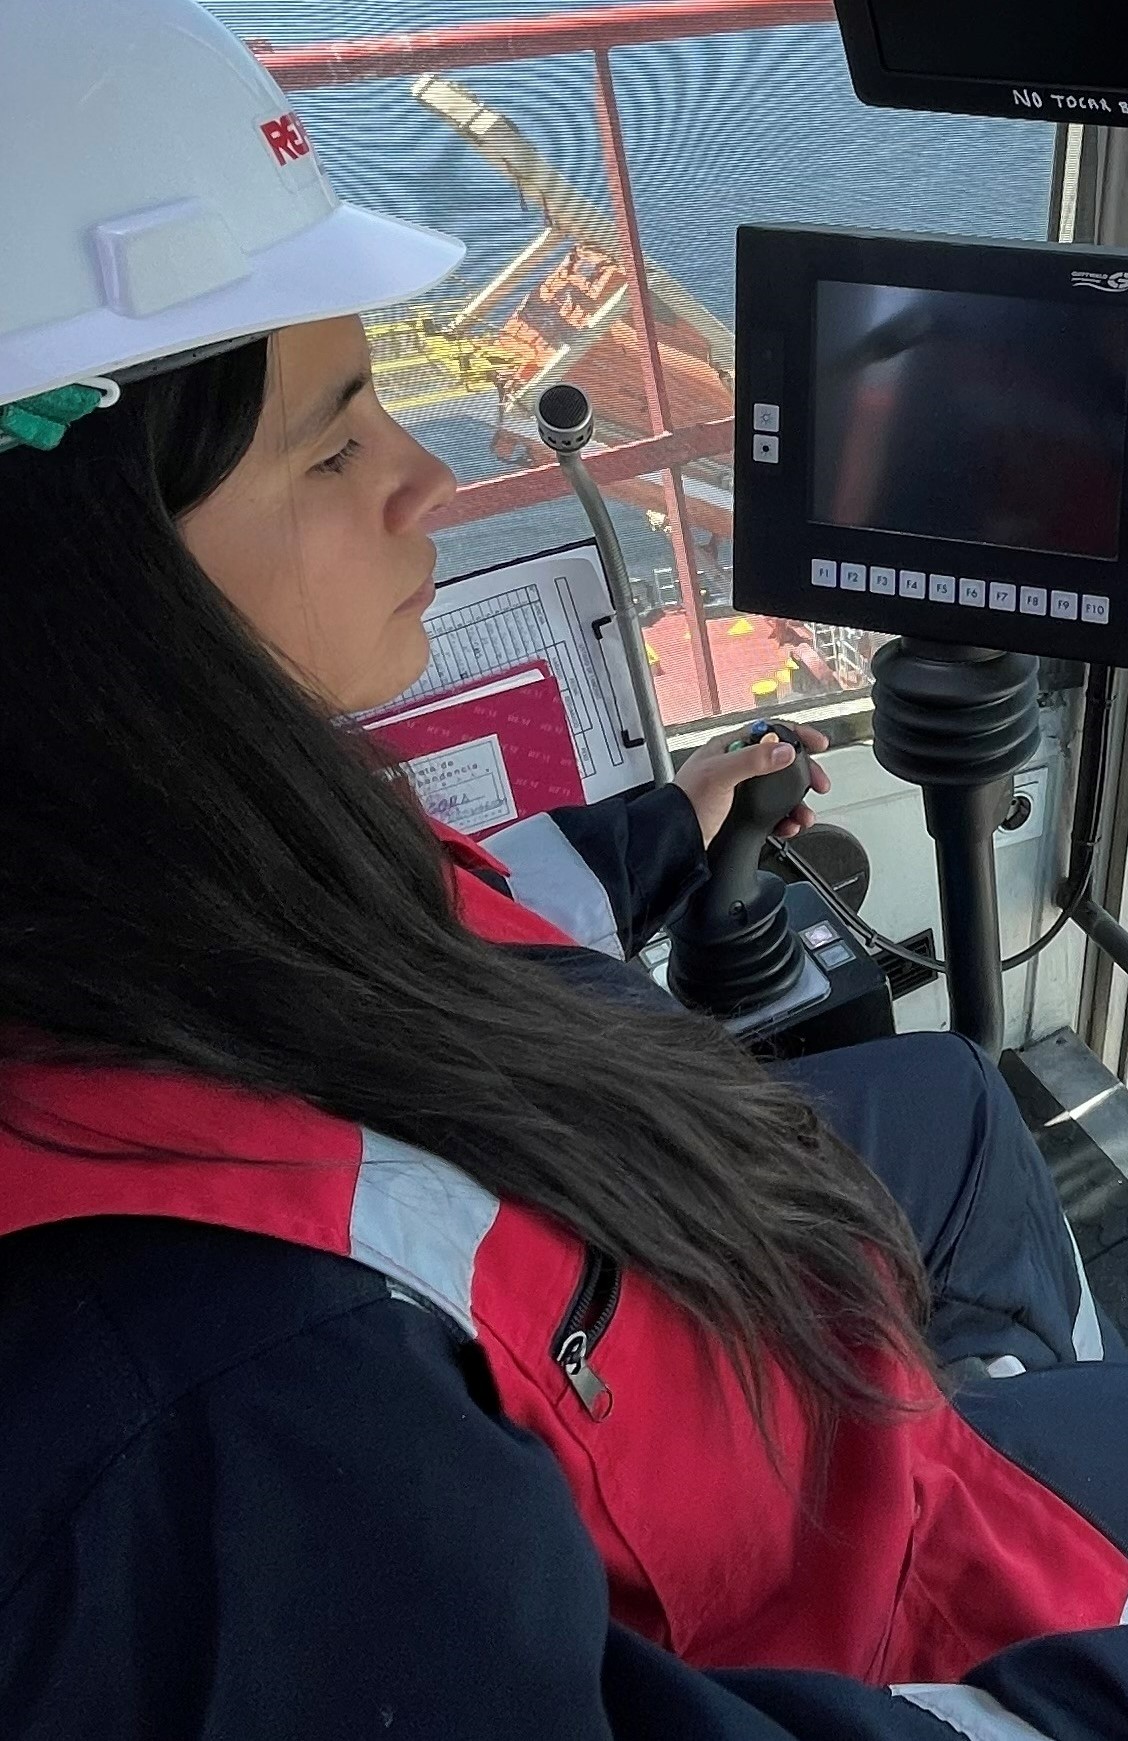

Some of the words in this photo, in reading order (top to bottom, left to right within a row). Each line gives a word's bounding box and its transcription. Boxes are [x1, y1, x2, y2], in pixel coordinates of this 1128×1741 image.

[1012, 89, 1043, 108] NO
[1050, 94, 1112, 113] TOCAR
[819, 567, 829, 578] F1
[847, 572, 859, 582] F2
[876, 575, 888, 586] F3
[906, 580, 918, 590] F4
[936, 583, 948, 594] F5
[966, 587, 978, 598] F6
[996, 592, 1008, 601] F7
[1027, 596, 1039, 606] F8
[1058, 600, 1070, 610] F9
[1086, 604, 1105, 615] F10
